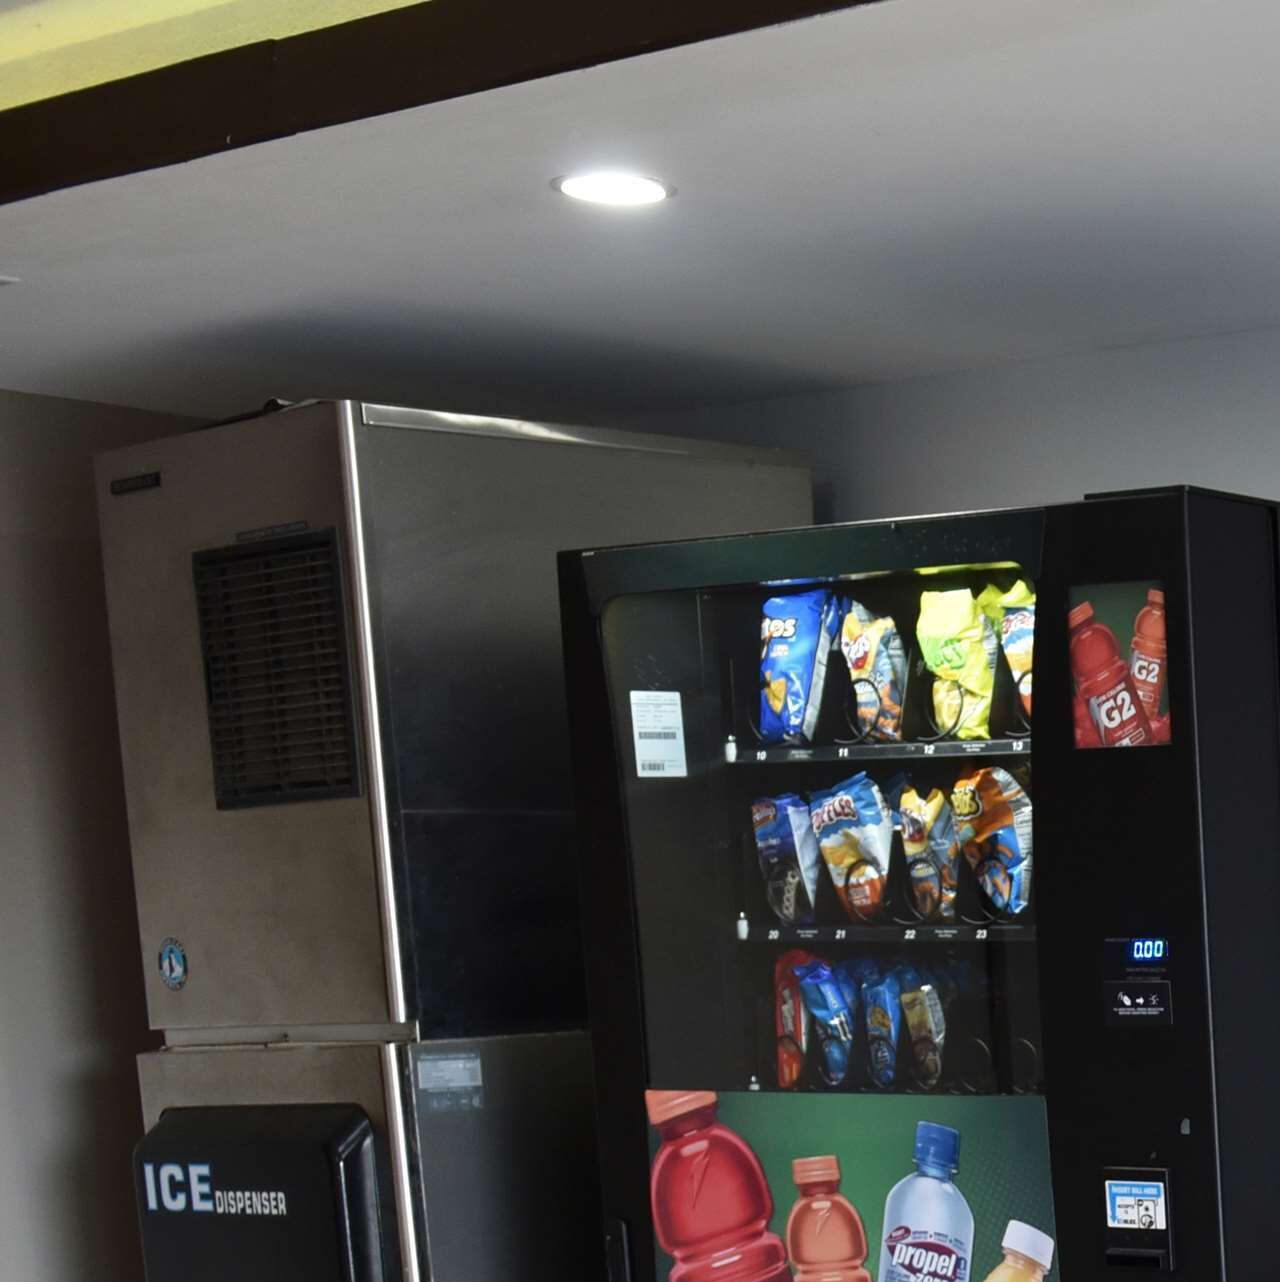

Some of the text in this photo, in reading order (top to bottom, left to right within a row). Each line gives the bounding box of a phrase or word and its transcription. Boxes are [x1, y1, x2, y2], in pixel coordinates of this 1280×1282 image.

[1134, 660, 1160, 683] G2
[1100, 690, 1136, 729] G2
[924, 744, 935, 755] 12
[1012, 741, 1023, 751] 13
[756, 751, 767, 761] 10
[838, 747, 849, 757] 11
[768, 930, 779, 940] 20
[835, 930, 847, 939] 21
[904, 930, 916, 939] 22
[975, 930, 988, 939] 23
[144, 1163, 287, 1215] ICE DISPENSER
[892, 1243, 957, 1277] propel
